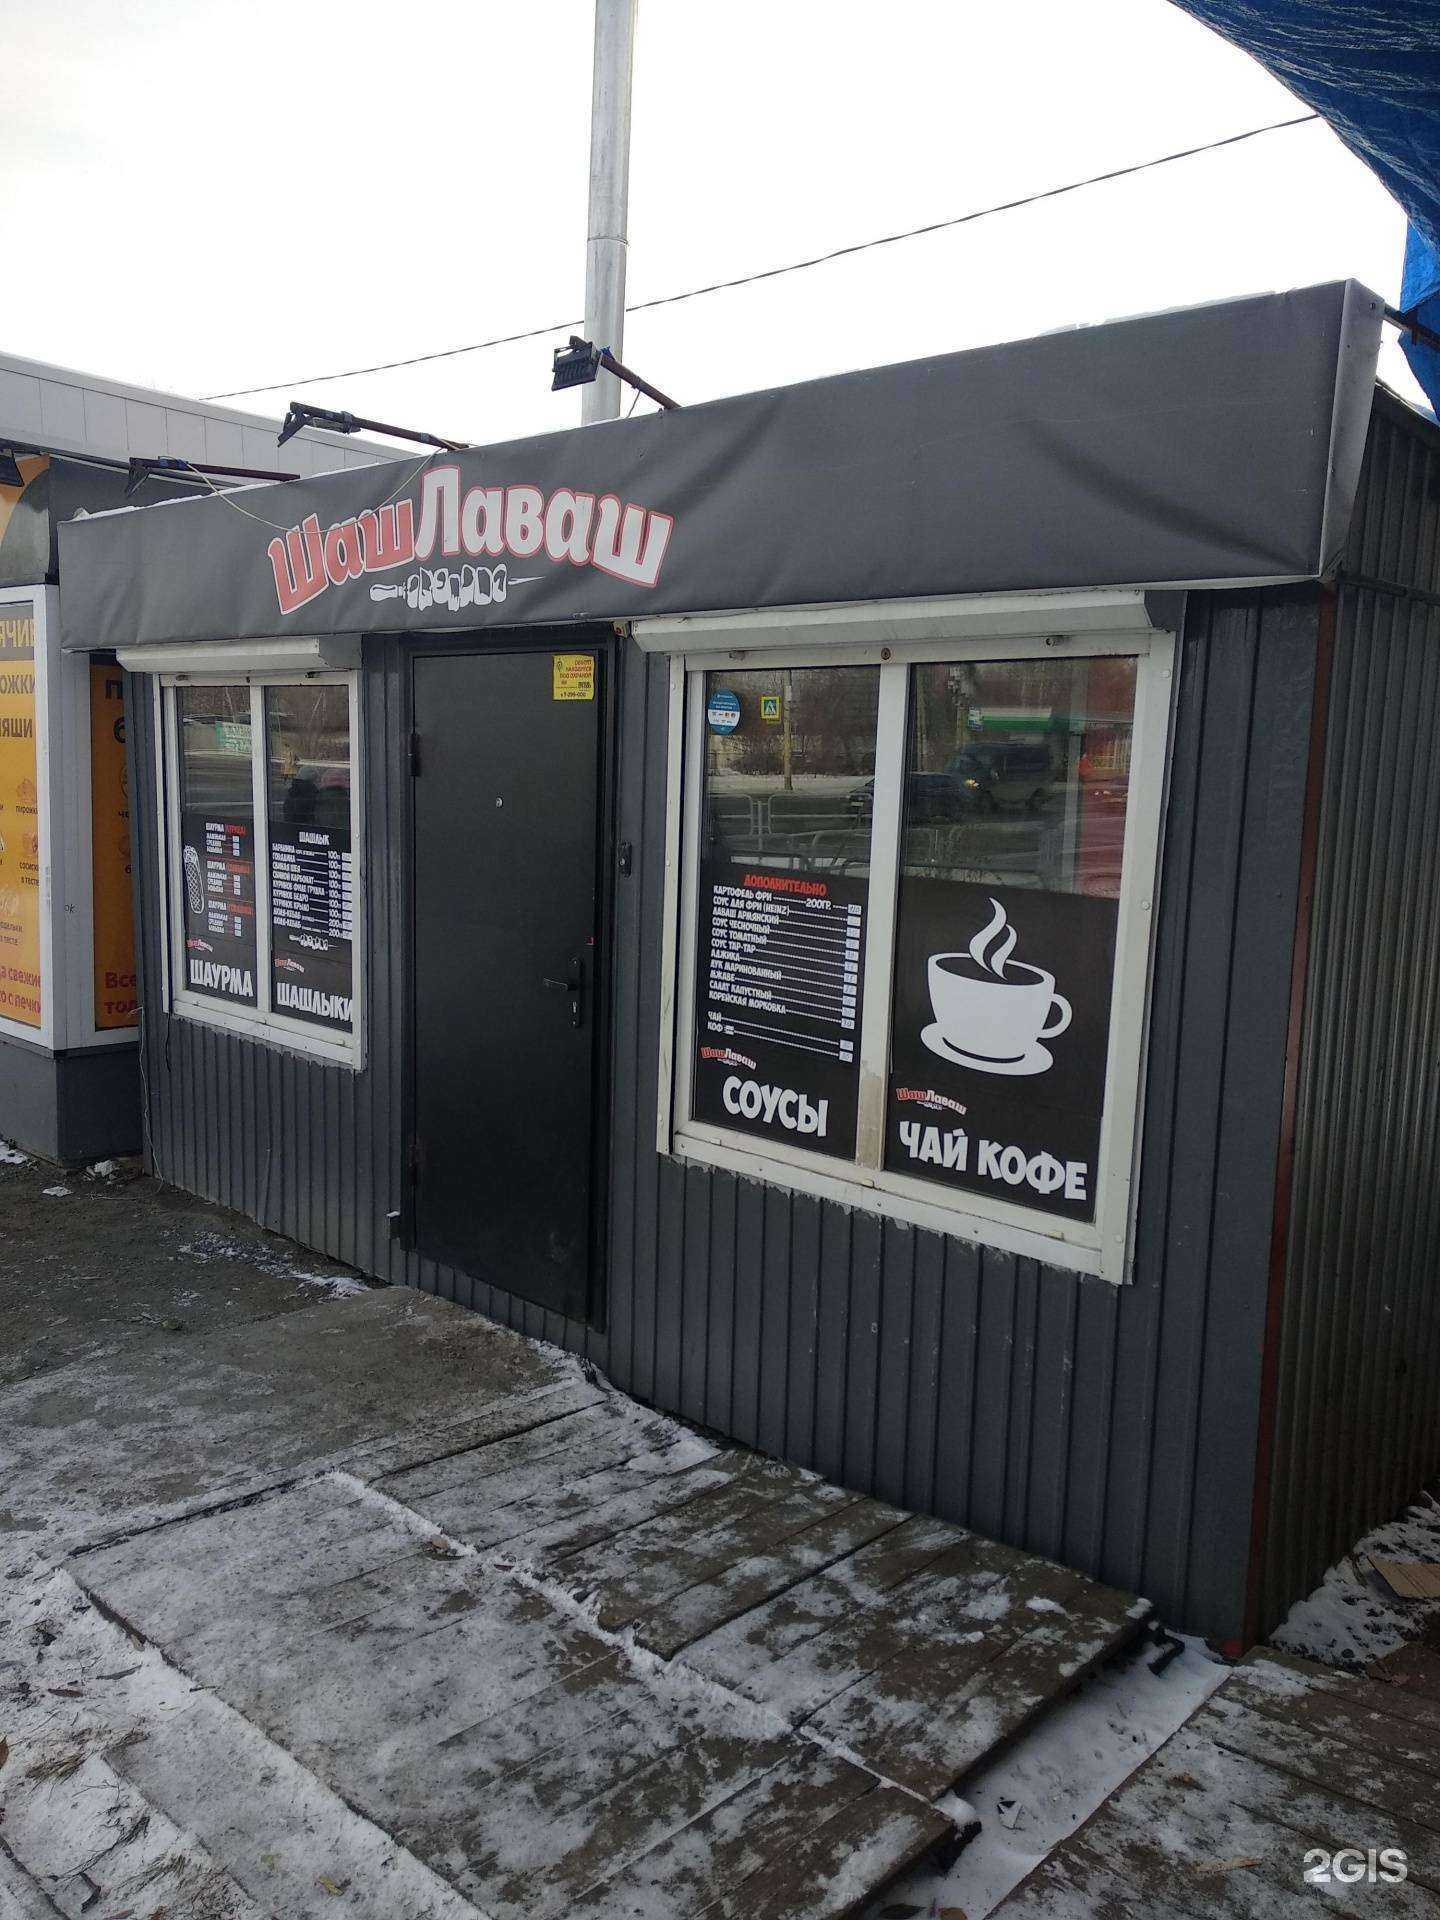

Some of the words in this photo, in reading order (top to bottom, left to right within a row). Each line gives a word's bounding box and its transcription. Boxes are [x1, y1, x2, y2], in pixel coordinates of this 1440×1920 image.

[713, 885, 755, 899] КАРТОФЕЛЬ
[755, 890, 773, 902] ФРИ
[743, 874, 827, 897] ДОПОЛНИТЕЛЬНО
[713, 895, 730, 907] СОУС
[730, 898, 745, 909] ДЛЯ
[745, 900, 762, 911] ФРИ
[712, 916, 729, 928] СОУС
[728, 919, 771, 934] ЧЕСНОЧНЫЙ
[711, 927, 728, 938] СОУС
[728, 930, 768, 945] ТОМАТНЫЙ
[711, 938, 728, 949] СОУС
[710, 948, 740, 962] АДЖИКА
[190, 959, 254, 997] ШАУРМА
[748, 997, 787, 1015] МОРКОВКА
[723, 1075, 829, 1137] СОУСЫ
[899, 1120, 969, 1172] ЧАЙ
[977, 1138, 1088, 1201] КОФЕ
